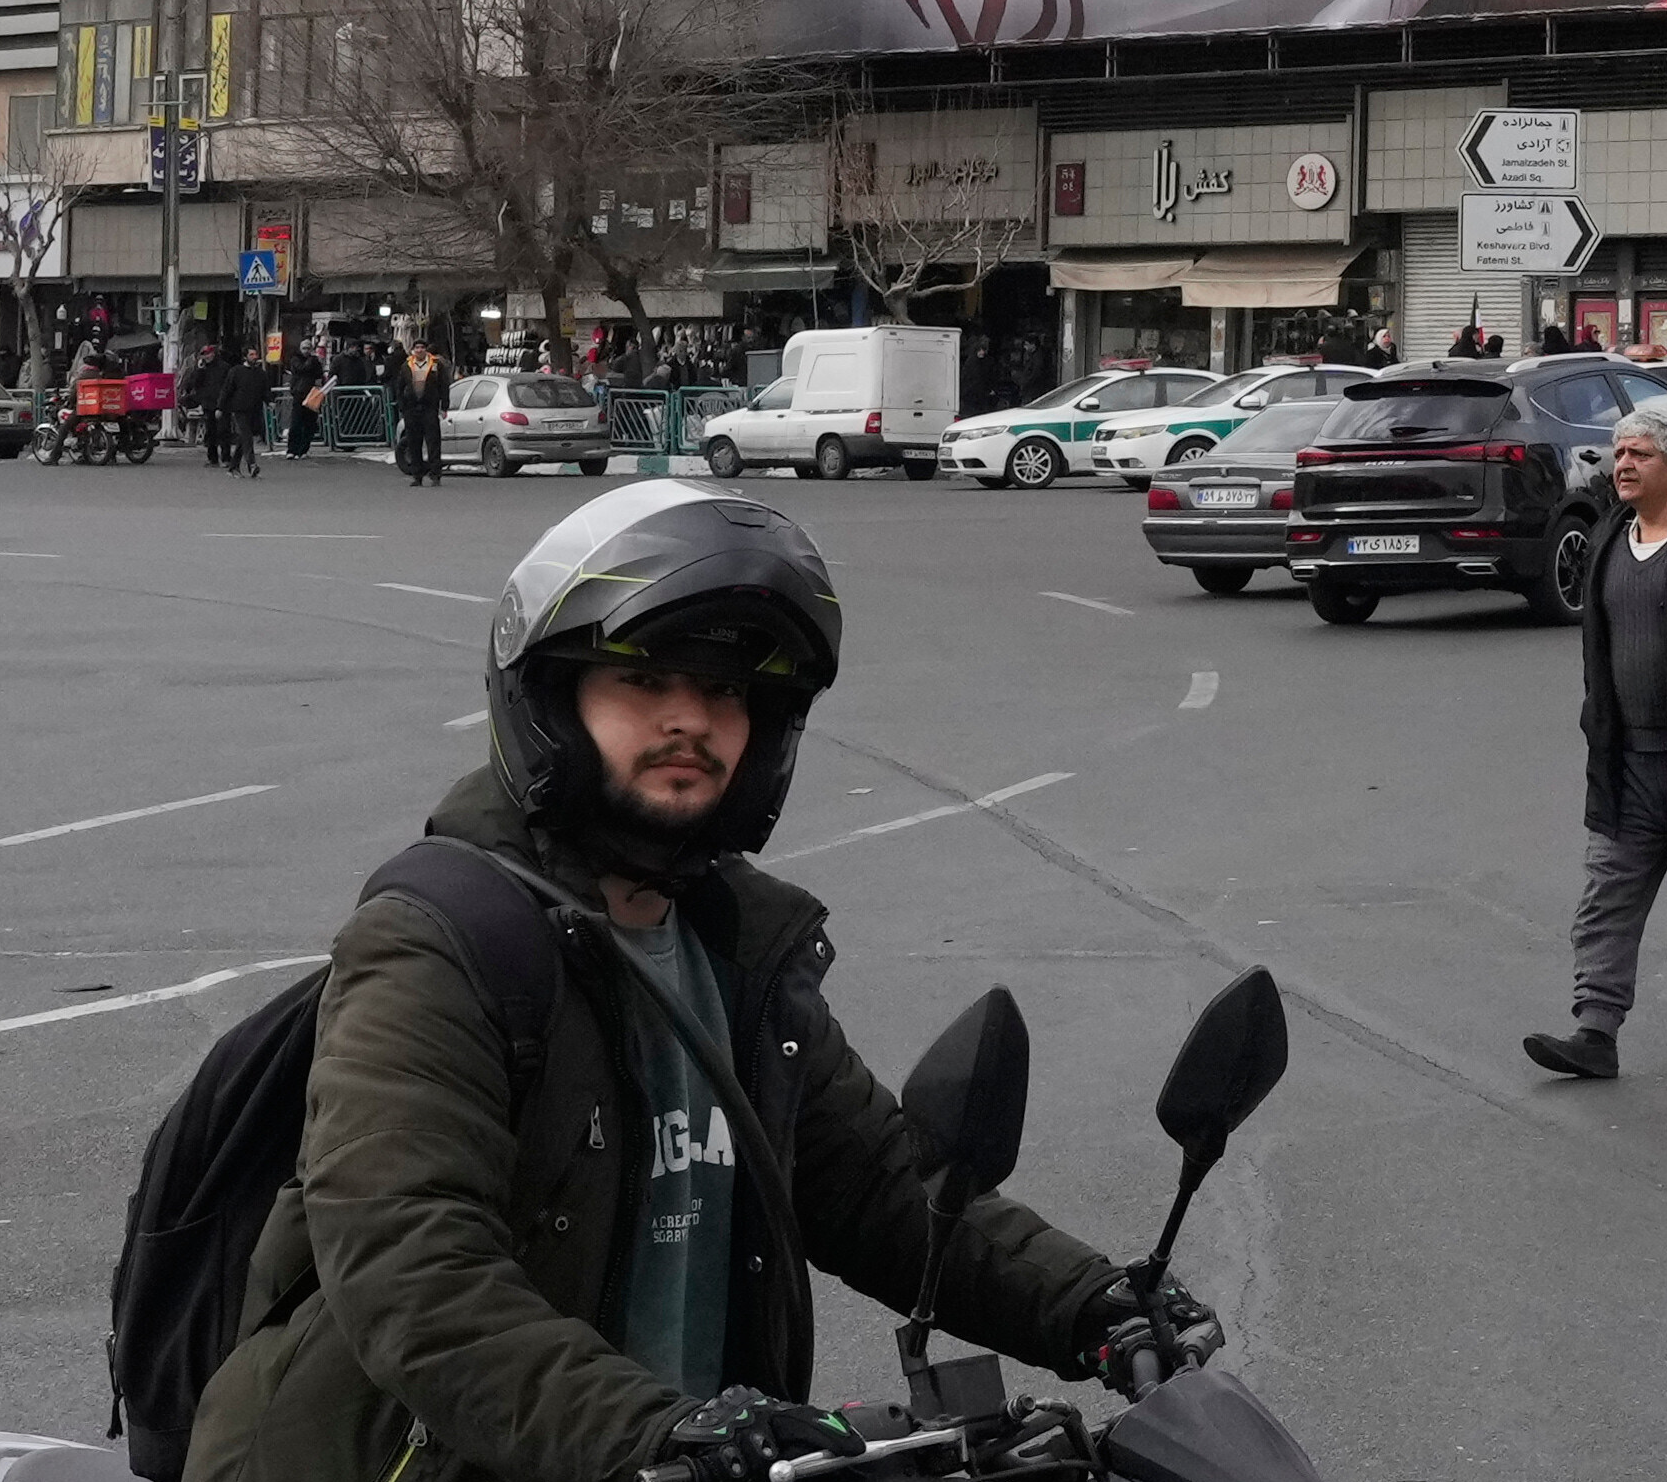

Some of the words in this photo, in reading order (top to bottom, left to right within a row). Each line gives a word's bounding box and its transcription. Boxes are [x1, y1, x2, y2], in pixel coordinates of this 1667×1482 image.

[1502, 118, 1553, 130] جمالزاده
[1516, 138, 1553, 153] آزادی
[1501, 173, 1528, 182] Azadi
[1183, 168, 1230, 201] کفش
[1494, 199, 1535, 213] کشاورز
[1496, 221, 1534, 234] فاطمی
[1529, 241, 1553, 251] Blvd.
[1477, 256, 1509, 265] Fatemi
